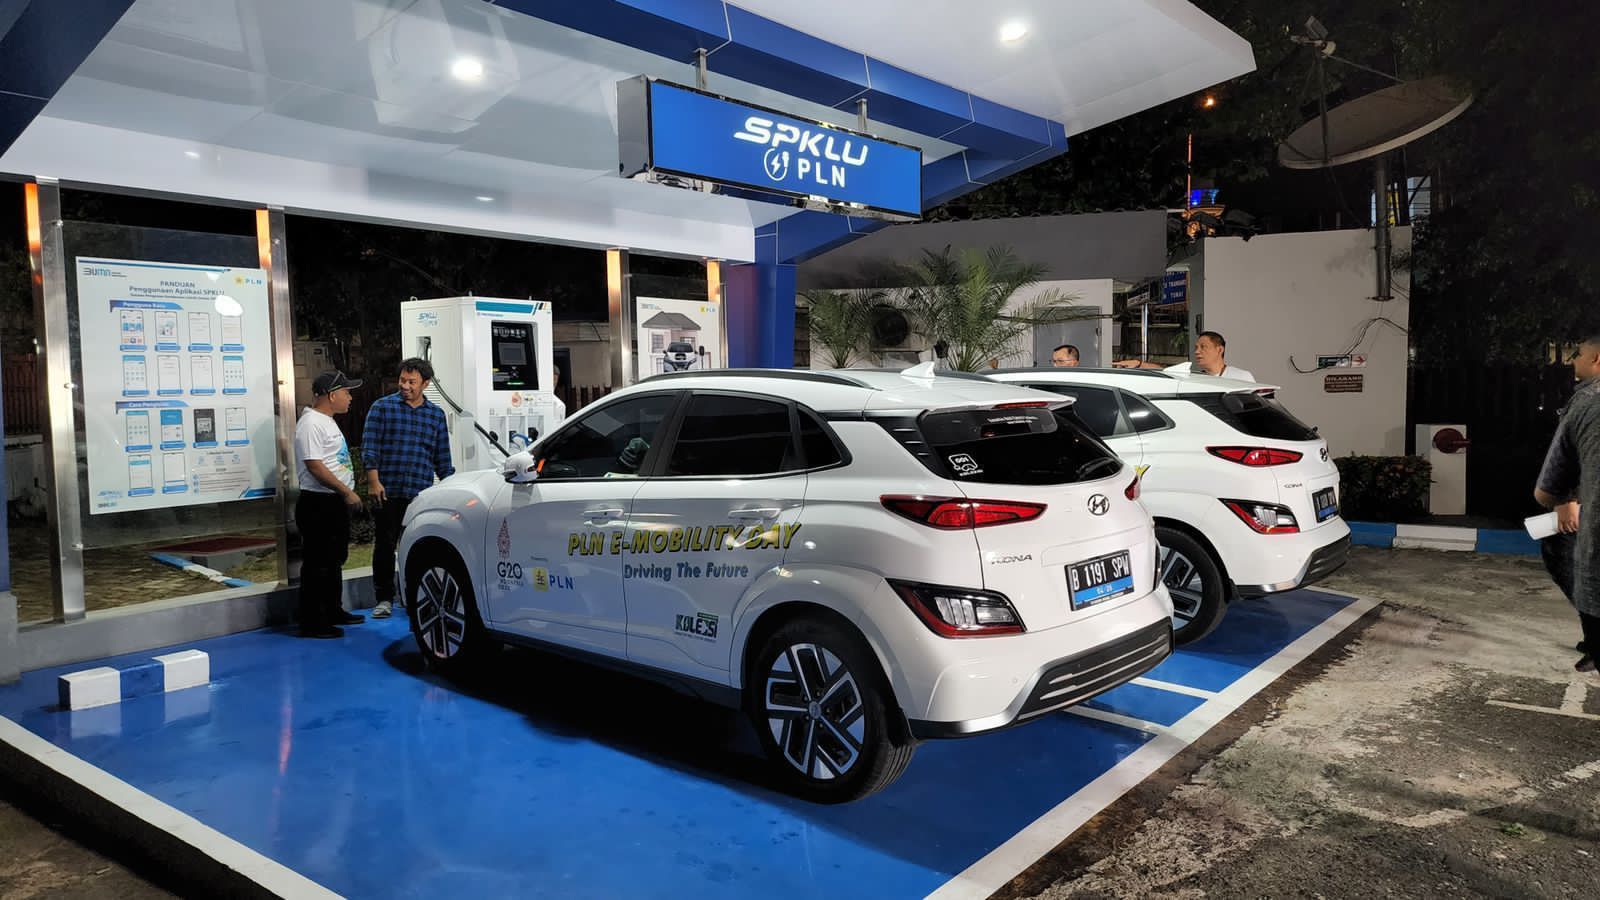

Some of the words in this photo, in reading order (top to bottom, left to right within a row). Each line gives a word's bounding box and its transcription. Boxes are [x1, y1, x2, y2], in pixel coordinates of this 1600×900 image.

[733, 116, 868, 167] SPKLU
[798, 158, 846, 188] PLN
[129, 286, 174, 295] Penggunaan
[245, 277, 262, 285] PLN
[567, 532, 605, 556] PLN
[610, 524, 745, 555] E-MOBILITY
[745, 522, 802, 549] DAY
[497, 561, 523, 580] G20
[624, 563, 672, 582] Driving
[676, 561, 701, 578] The
[705, 562, 749, 578] Future
[1072, 568, 1080, 591] B
[1084, 561, 1107, 587] 1191
[549, 574, 574, 590] PLN
